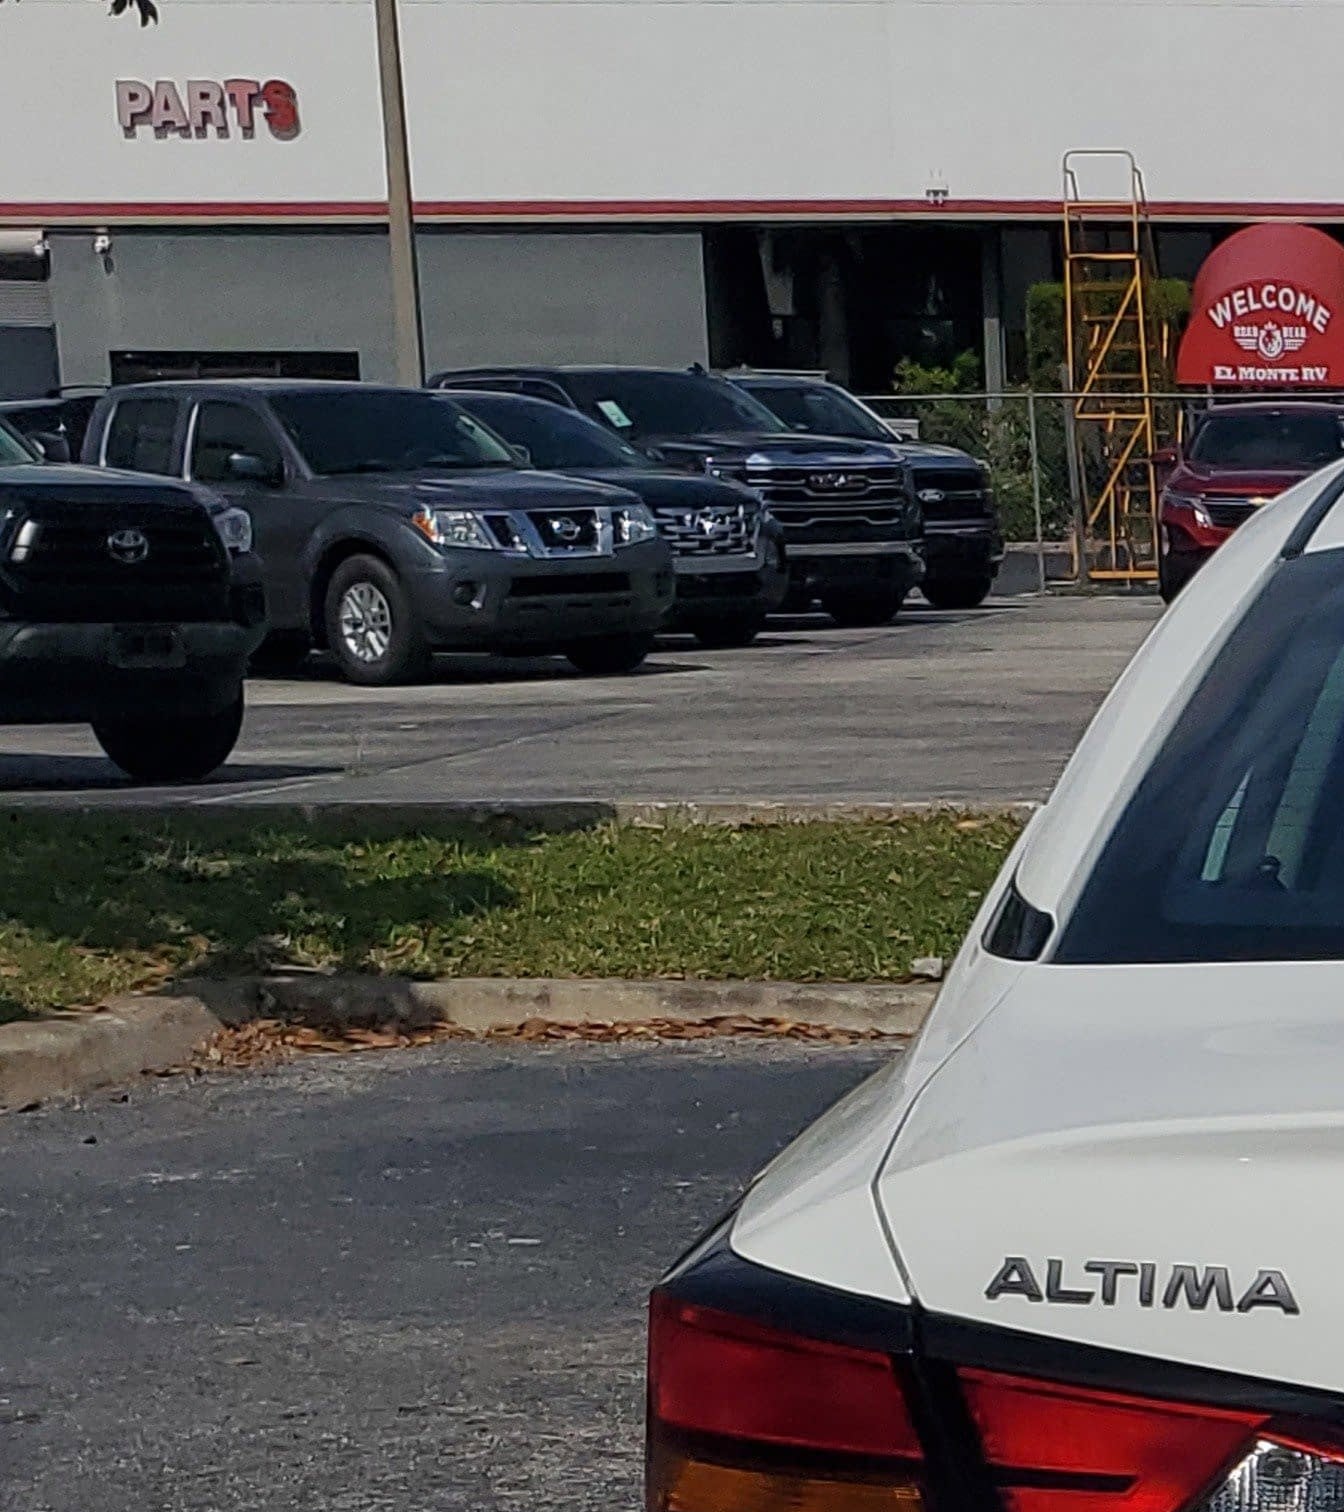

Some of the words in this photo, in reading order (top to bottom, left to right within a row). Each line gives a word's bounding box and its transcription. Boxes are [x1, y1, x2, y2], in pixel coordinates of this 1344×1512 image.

[115, 79, 300, 140] PARTS
[1208, 284, 1331, 334] WELCOME
[1213, 365, 1236, 380] EL
[1237, 365, 1299, 381] MONTE
[1301, 366, 1328, 380] RV
[985, 1256, 1301, 1316] ALTIMA
